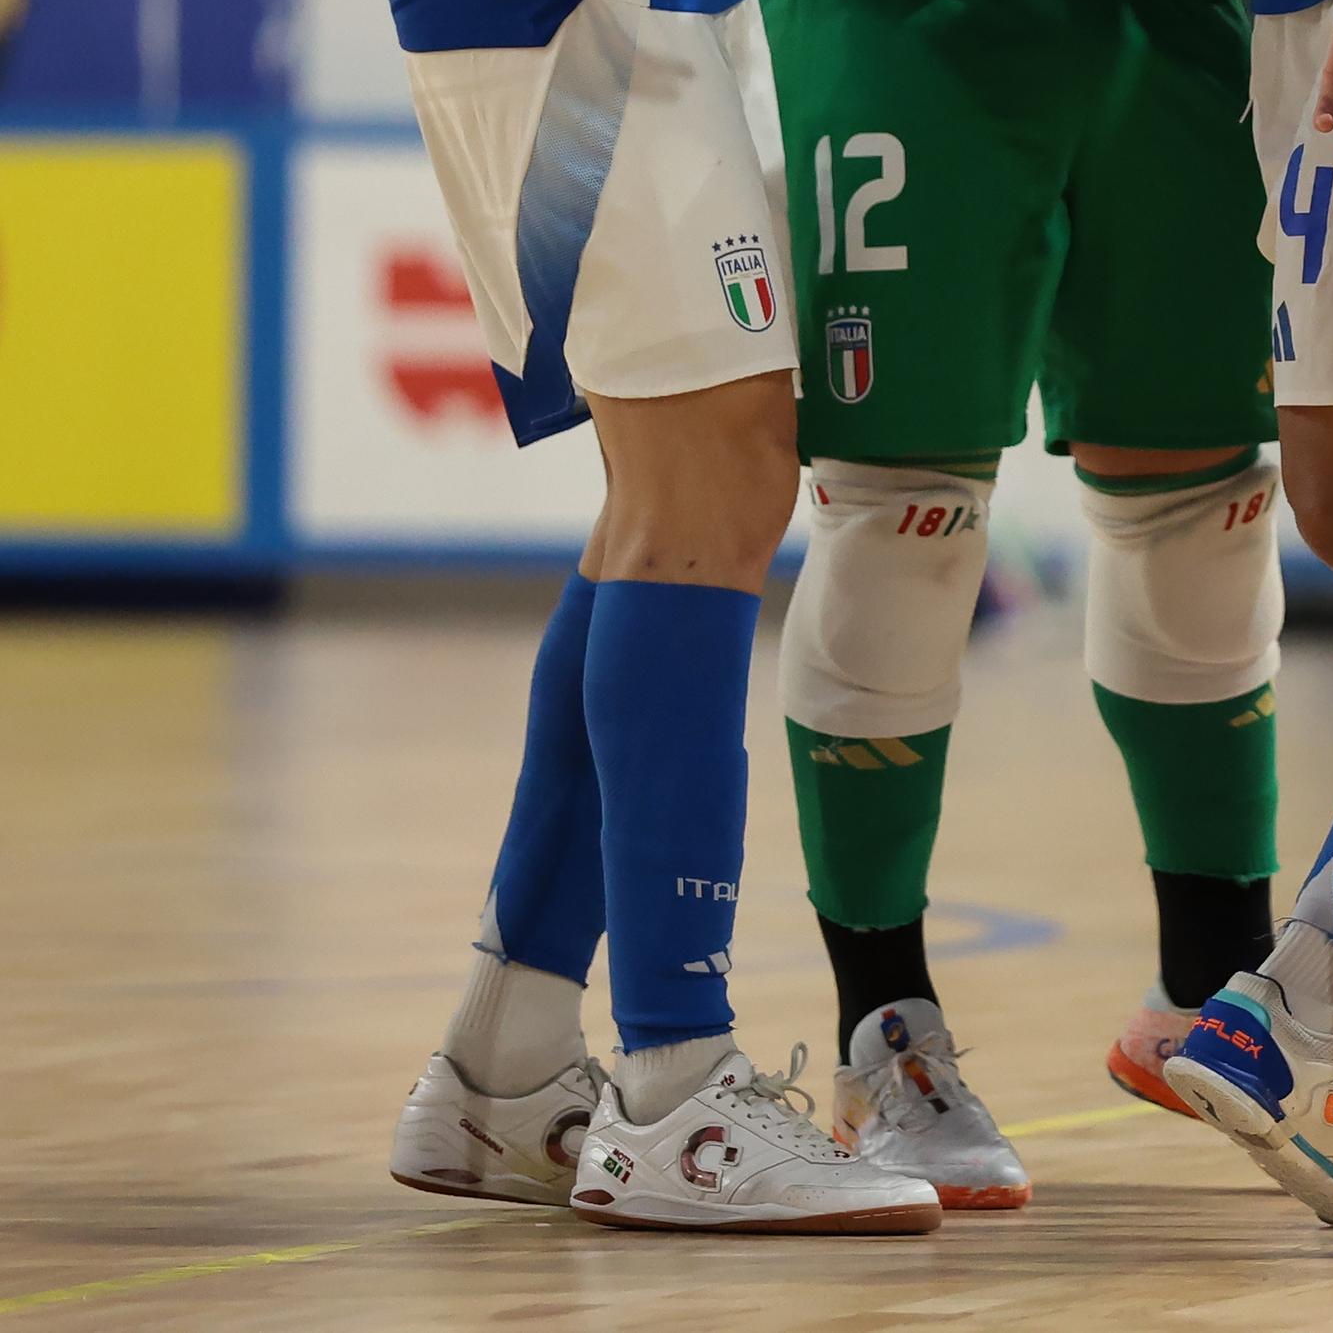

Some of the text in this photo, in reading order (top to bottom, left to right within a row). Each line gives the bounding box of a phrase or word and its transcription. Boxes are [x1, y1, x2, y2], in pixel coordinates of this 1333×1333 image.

[814, 132, 909, 276] 12
[720, 254, 763, 276] ITALIA
[831, 325, 868, 343] ITALIA
